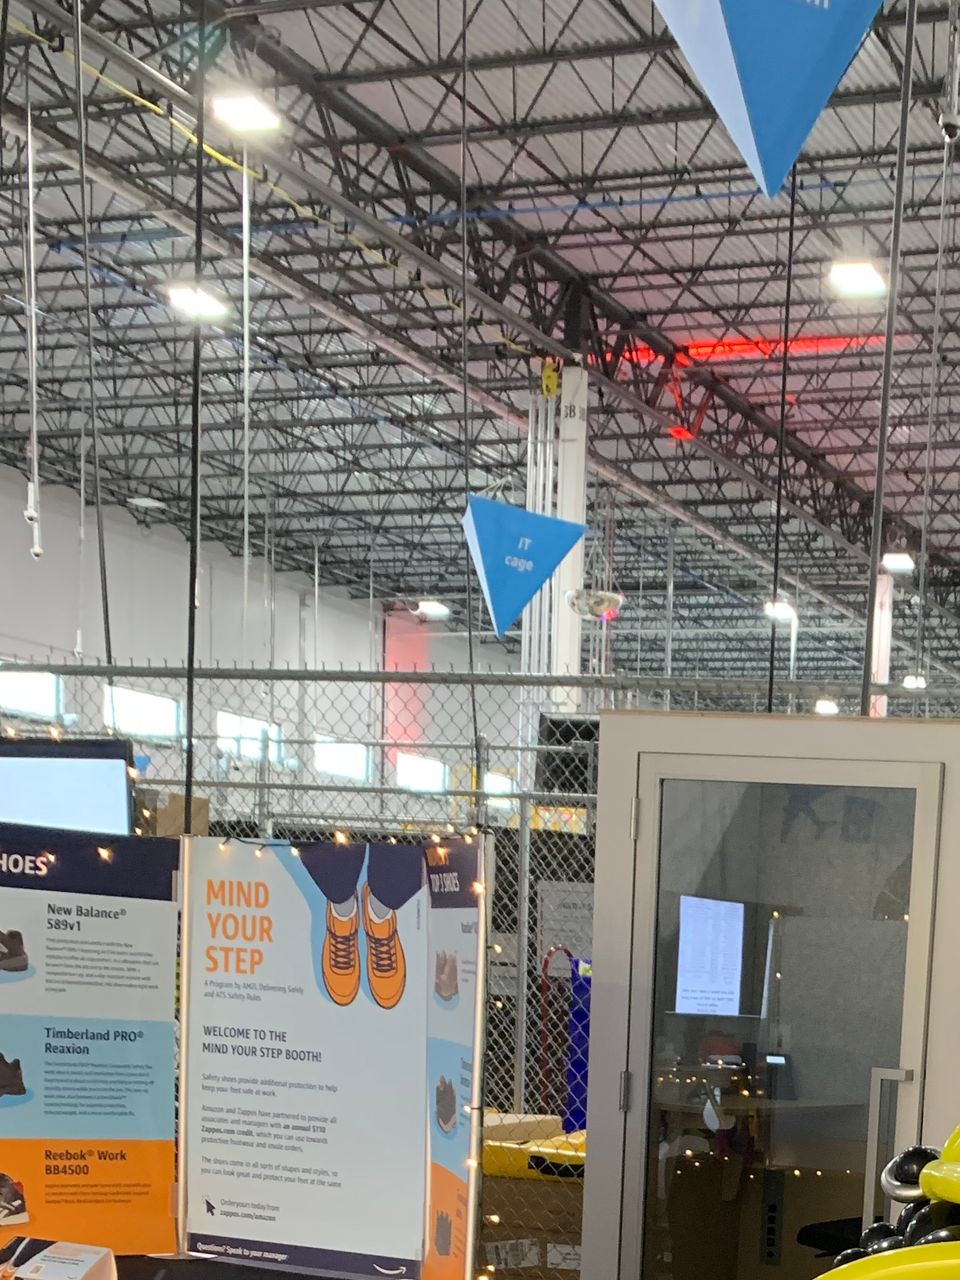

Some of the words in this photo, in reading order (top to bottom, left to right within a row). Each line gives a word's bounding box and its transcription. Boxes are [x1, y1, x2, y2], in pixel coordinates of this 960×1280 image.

[518, 537, 532, 551] IT
[505, 555, 534, 571] cage
[206, 879, 270, 909] MIND
[47, 903, 72, 916] New
[46, 918, 81, 931] 589v1
[207, 911, 273, 943] YOUR
[205, 945, 264, 976] STEP
[44, 1027, 110, 1041] Timberland
[203, 1025, 251, 1040] WELCOME
[253, 1028, 267, 1041] TO
[268, 1030, 287, 1042] THE
[44, 1042, 90, 1055] Reaxion
[202, 1042, 228, 1055] MIND
[230, 1044, 258, 1057] YOUR
[259, 1046, 283, 1059] STEP
[285, 1049, 322, 1063] BOOTH!
[96, 1150, 127, 1161] Work
[45, 1164, 89, 1176] BB4500
